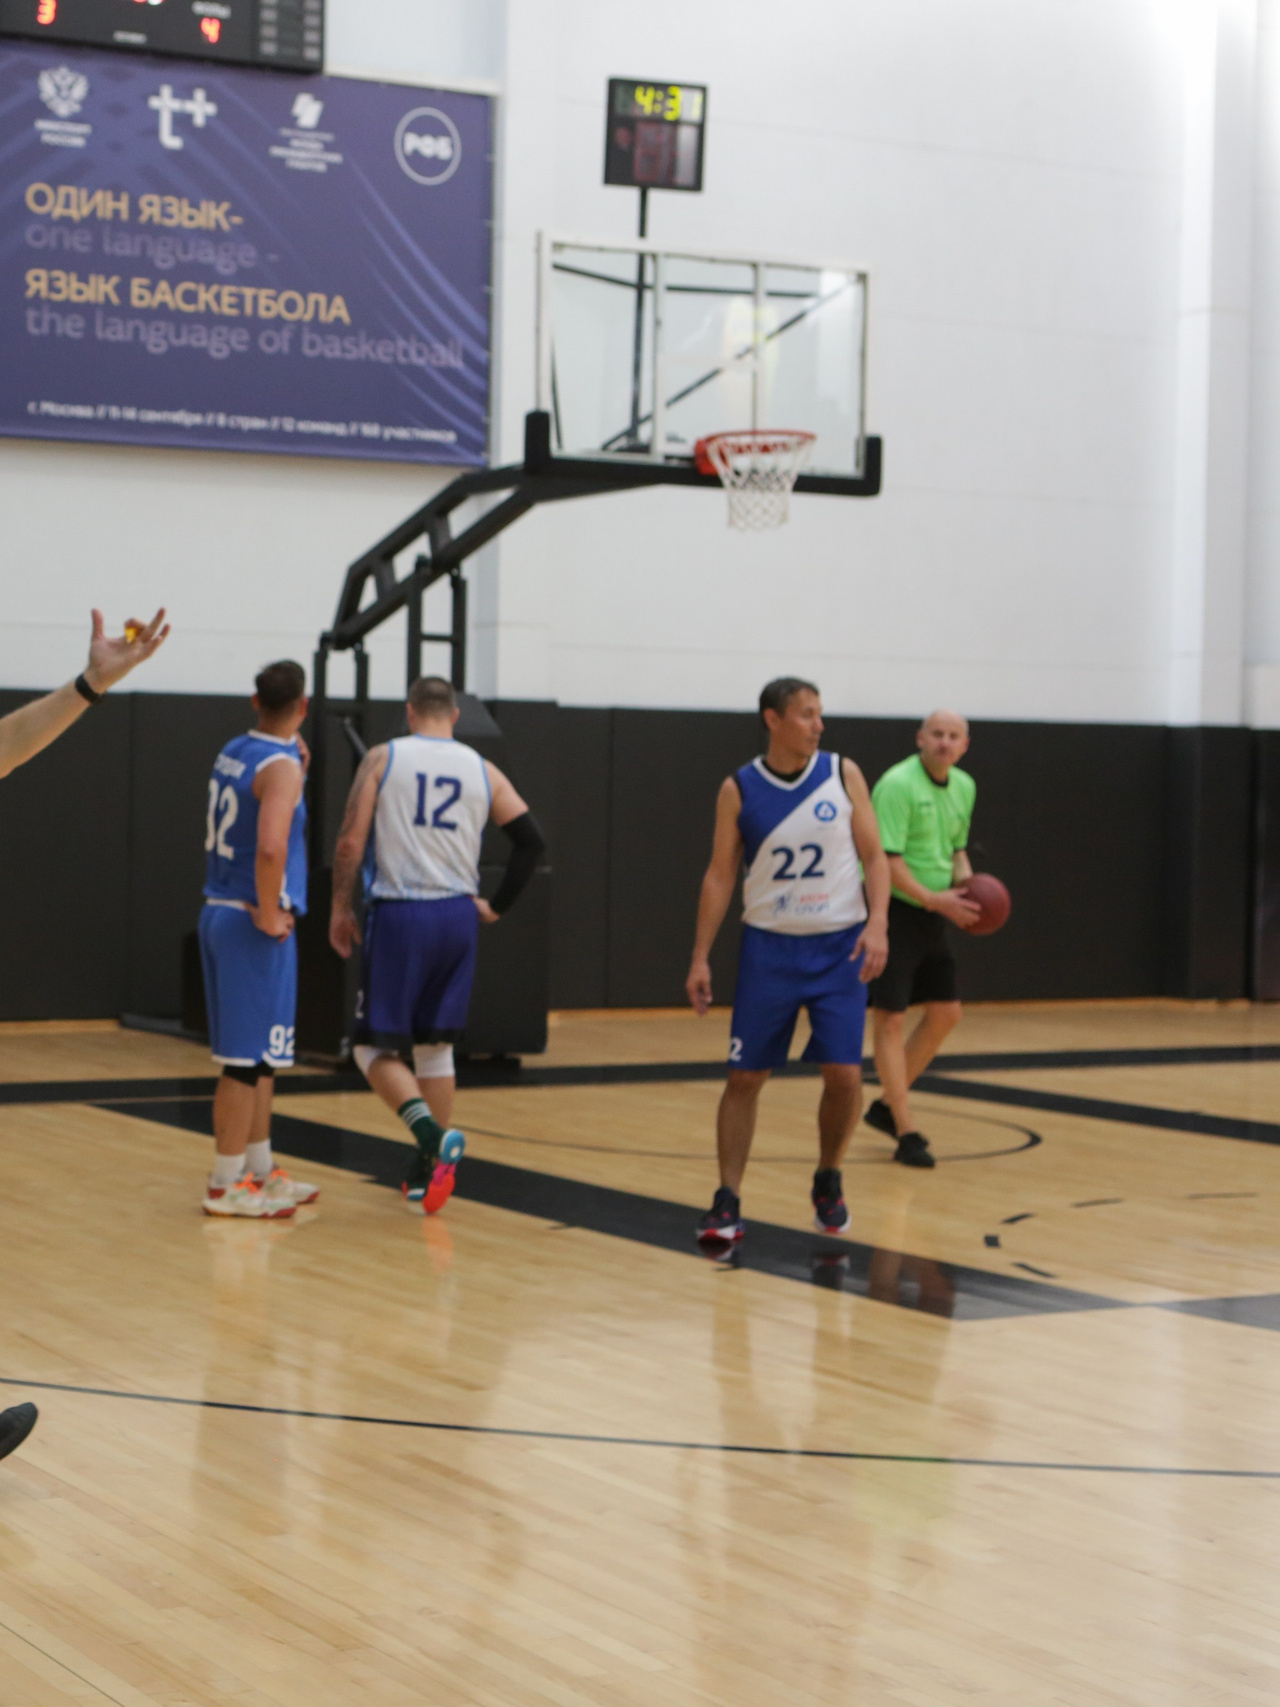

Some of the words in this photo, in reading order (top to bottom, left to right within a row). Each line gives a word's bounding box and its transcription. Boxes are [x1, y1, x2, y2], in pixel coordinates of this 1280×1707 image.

[201, 17, 220, 43] 4
[24, 181, 129, 222] ОДИН
[24, 223, 93, 253] one
[102, 224, 258, 275] language
[24, 268, 120, 305] ЯЗЫК
[129, 278, 351, 325] БАСКЕТБОЛА
[24, 306, 85, 339] the
[95, 308, 250, 359] language
[258, 323, 297, 355] of
[303, 328, 464, 369] basketball
[413, 772, 462, 831] 12
[771, 843, 825, 881] 22
